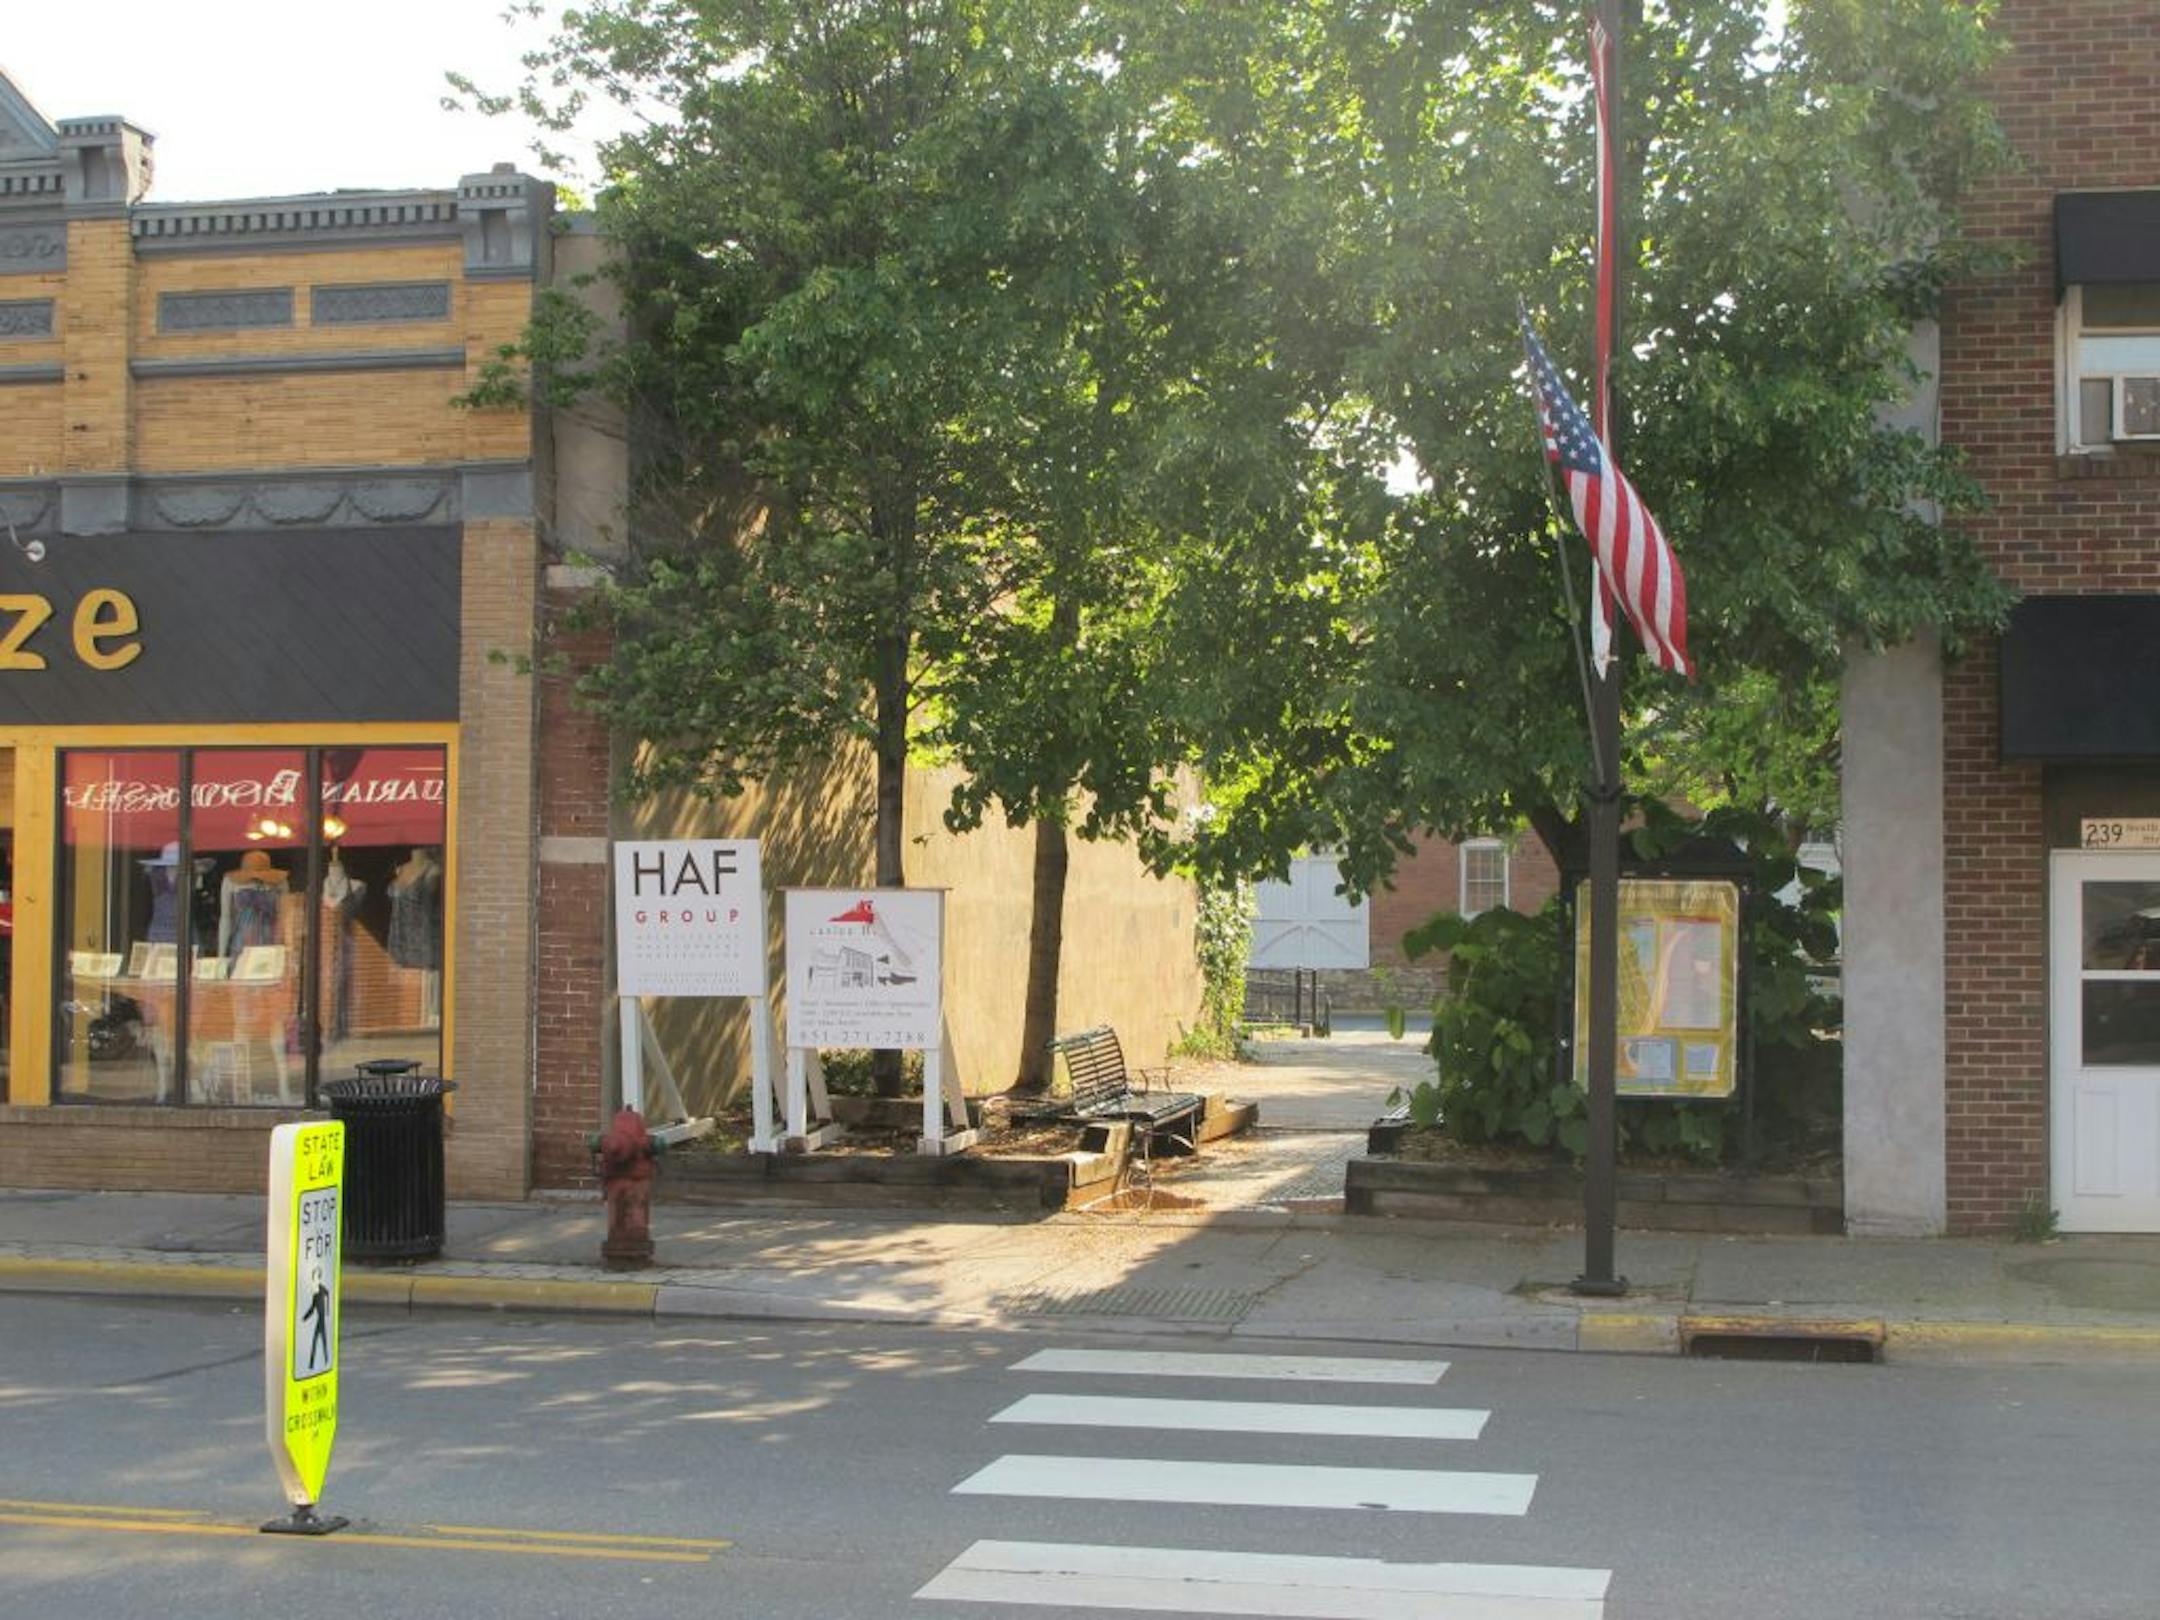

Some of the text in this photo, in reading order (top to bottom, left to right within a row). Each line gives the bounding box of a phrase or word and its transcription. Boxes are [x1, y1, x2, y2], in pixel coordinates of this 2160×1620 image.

[0, 587, 144, 670] ze
[2086, 824, 2123, 845] 239
[633, 850, 737, 896] HAF
[635, 909, 740, 924] GROUP
[303, 1132, 341, 1155] STATE
[309, 1161, 334, 1181] LAW
[302, 1198, 336, 1225] STOP
[305, 1234, 332, 1260] FOR
